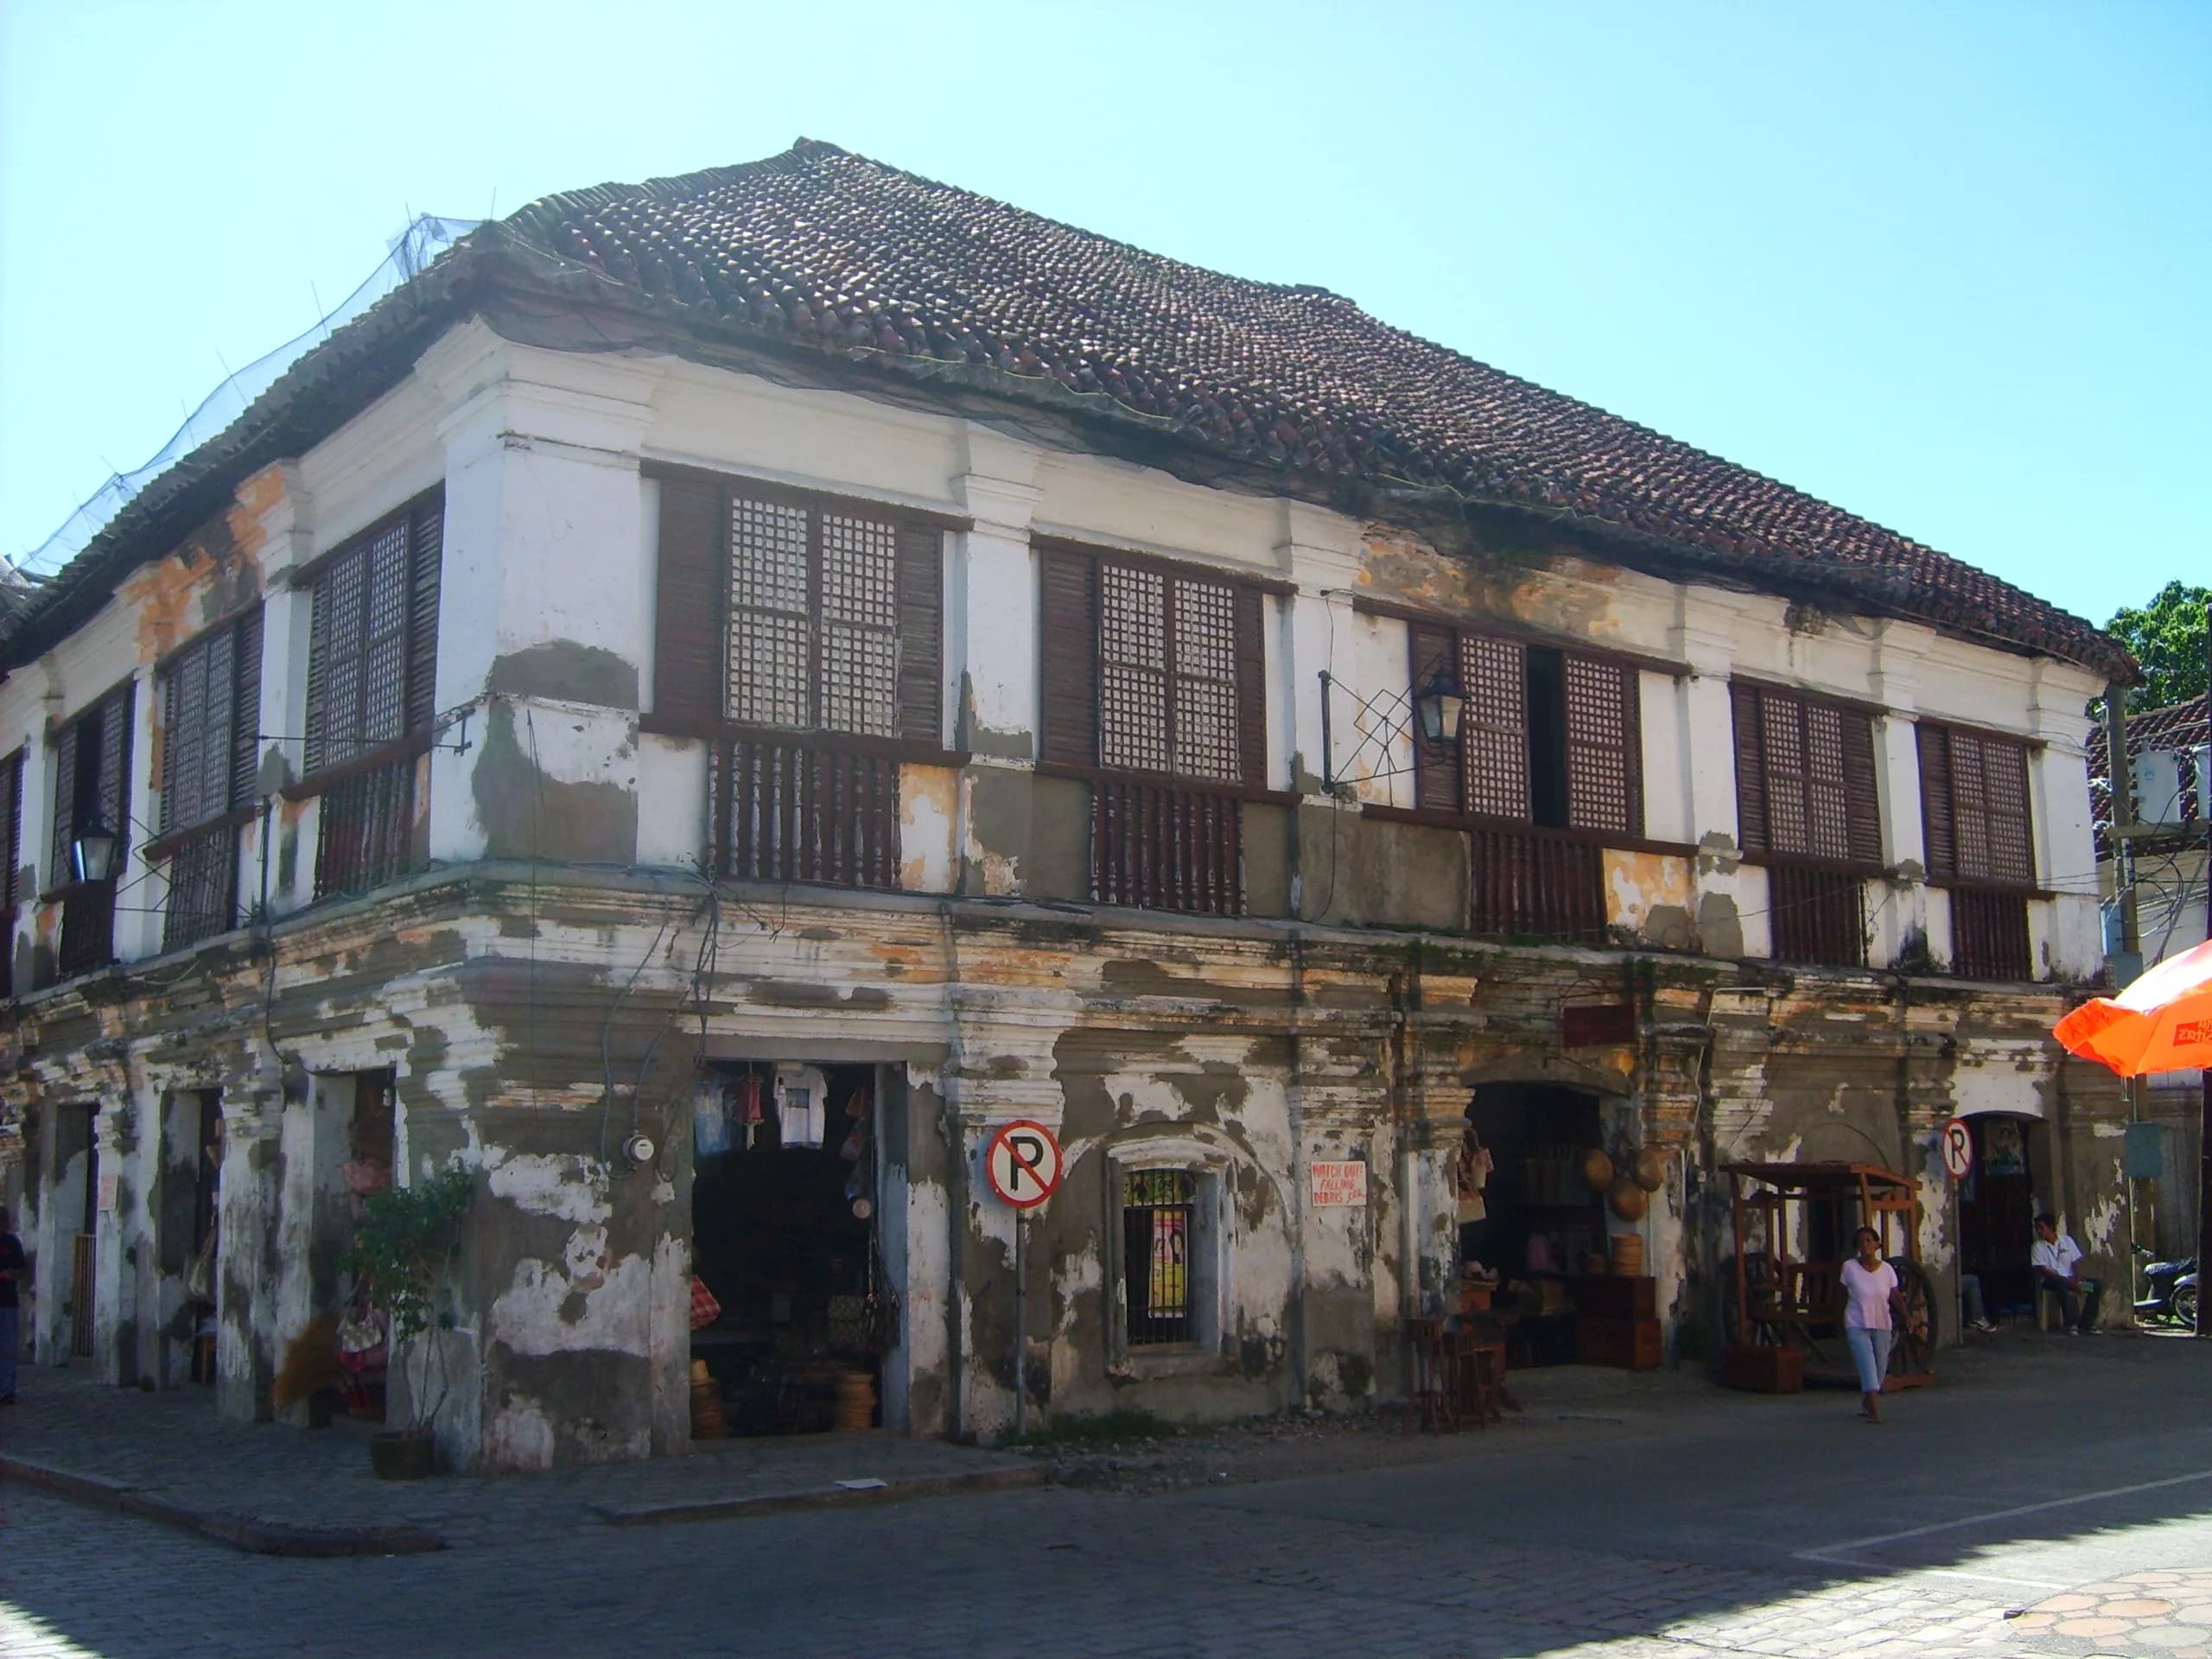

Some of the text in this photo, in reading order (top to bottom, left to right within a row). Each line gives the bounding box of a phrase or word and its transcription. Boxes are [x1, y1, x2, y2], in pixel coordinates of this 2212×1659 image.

[1951, 1129, 1965, 1168] P
[1009, 1135, 1044, 1192] P
[1313, 1191, 1343, 1204] DEBRIS
[1319, 1179, 1355, 1191] FALLING
